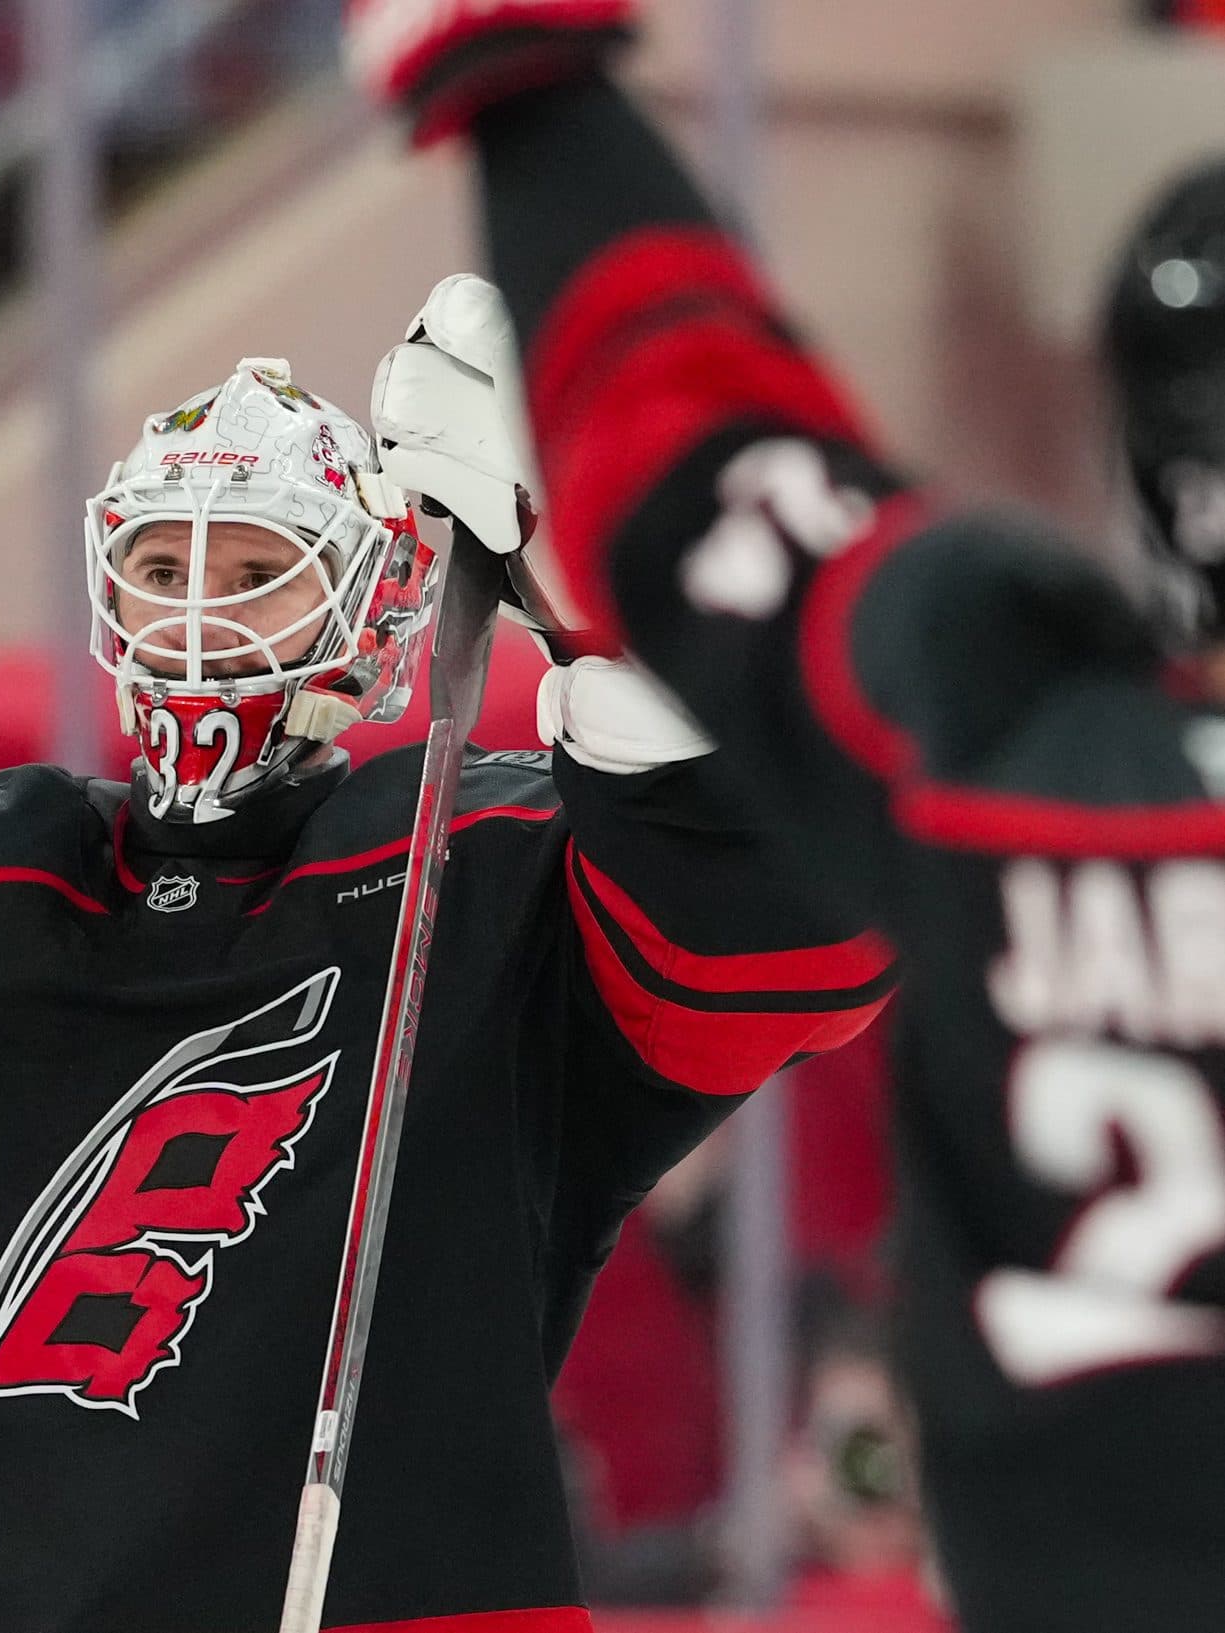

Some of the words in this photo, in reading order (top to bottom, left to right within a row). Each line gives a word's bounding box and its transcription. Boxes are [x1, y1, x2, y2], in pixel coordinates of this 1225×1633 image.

[159, 452, 260, 467] BAUER
[148, 708, 241, 824] 32
[158, 886, 188, 905] NHL
[974, 1032, 1225, 1388] 2
